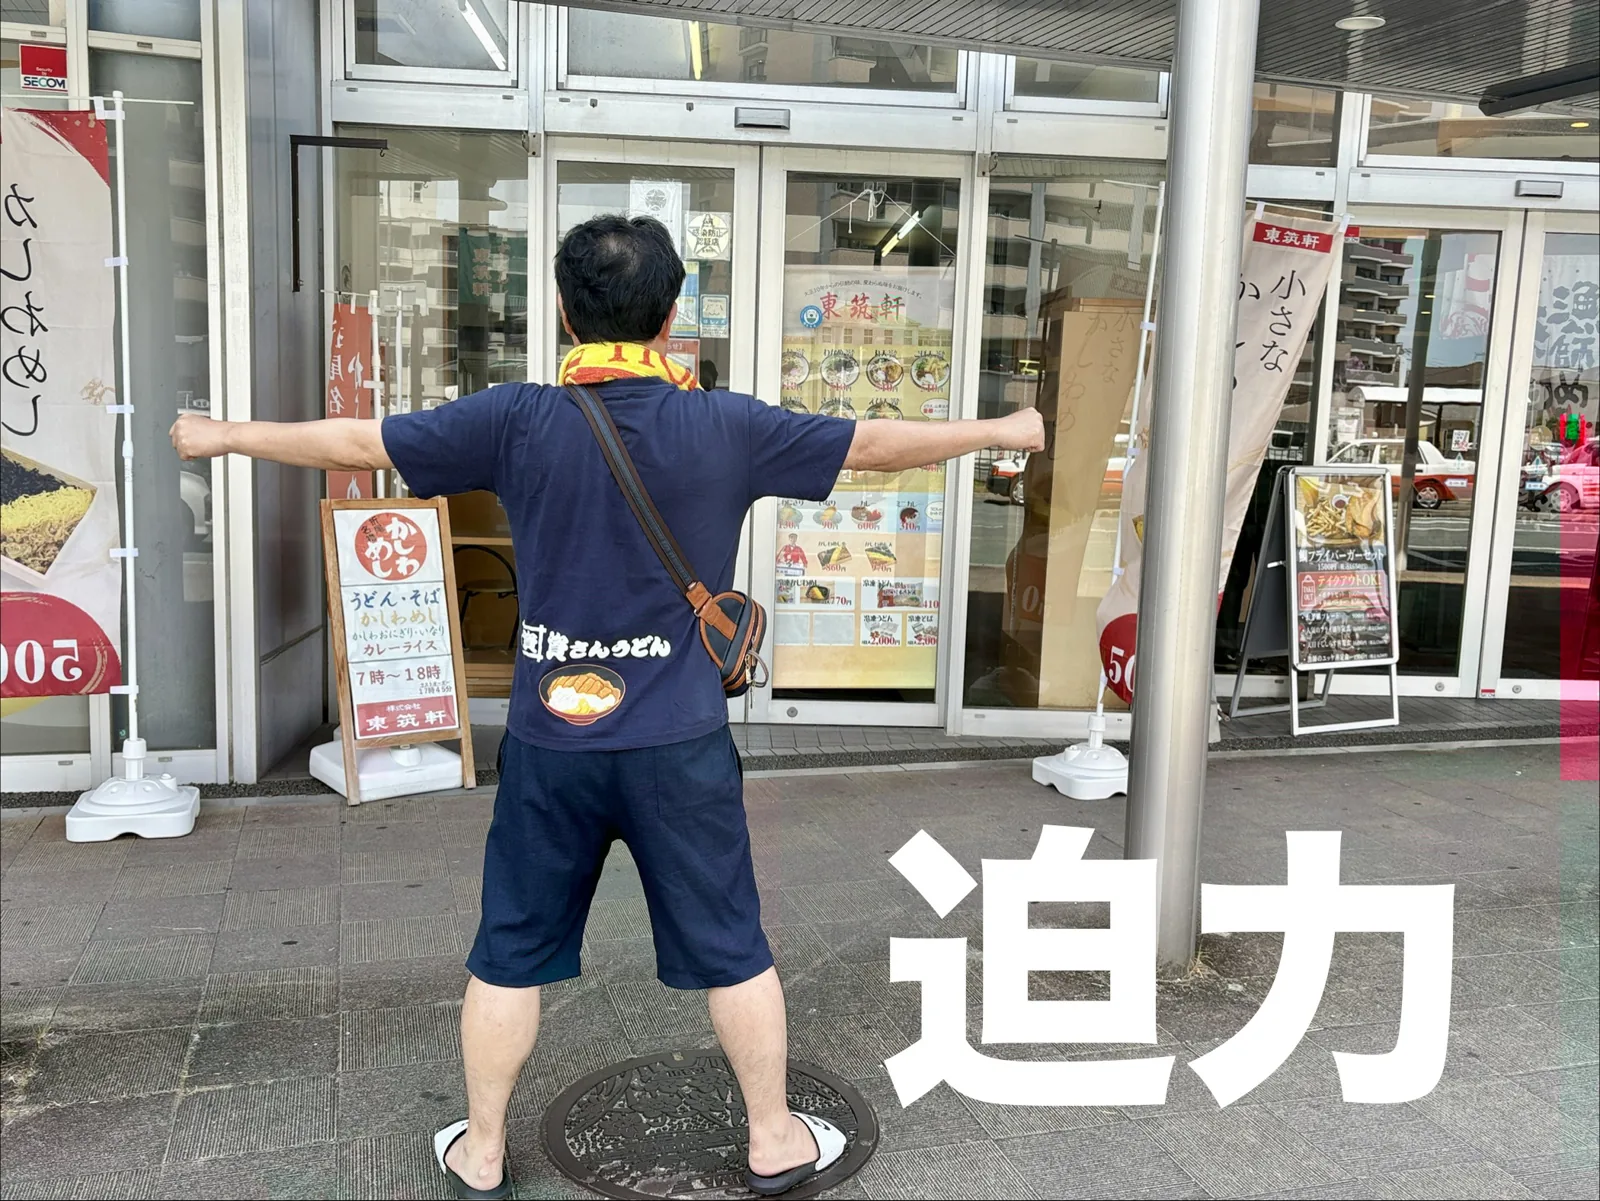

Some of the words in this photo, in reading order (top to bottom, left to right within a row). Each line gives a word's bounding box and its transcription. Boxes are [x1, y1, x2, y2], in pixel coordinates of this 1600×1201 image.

[23, 76, 66, 89] SECOM
[1263, 227, 1320, 250] 東筑軒
[819, 291, 906, 321] 東筑軒
[1260, 269, 1306, 373] 小さな
[350, 588, 441, 611] うどん・そば
[360, 606, 439, 629] かしわめし
[362, 640, 438, 657] カレーライス
[546, 631, 671, 662] 資さんうどん
[386, 703, 422, 713] 株式会社
[366, 710, 447, 732] 東筑軒
